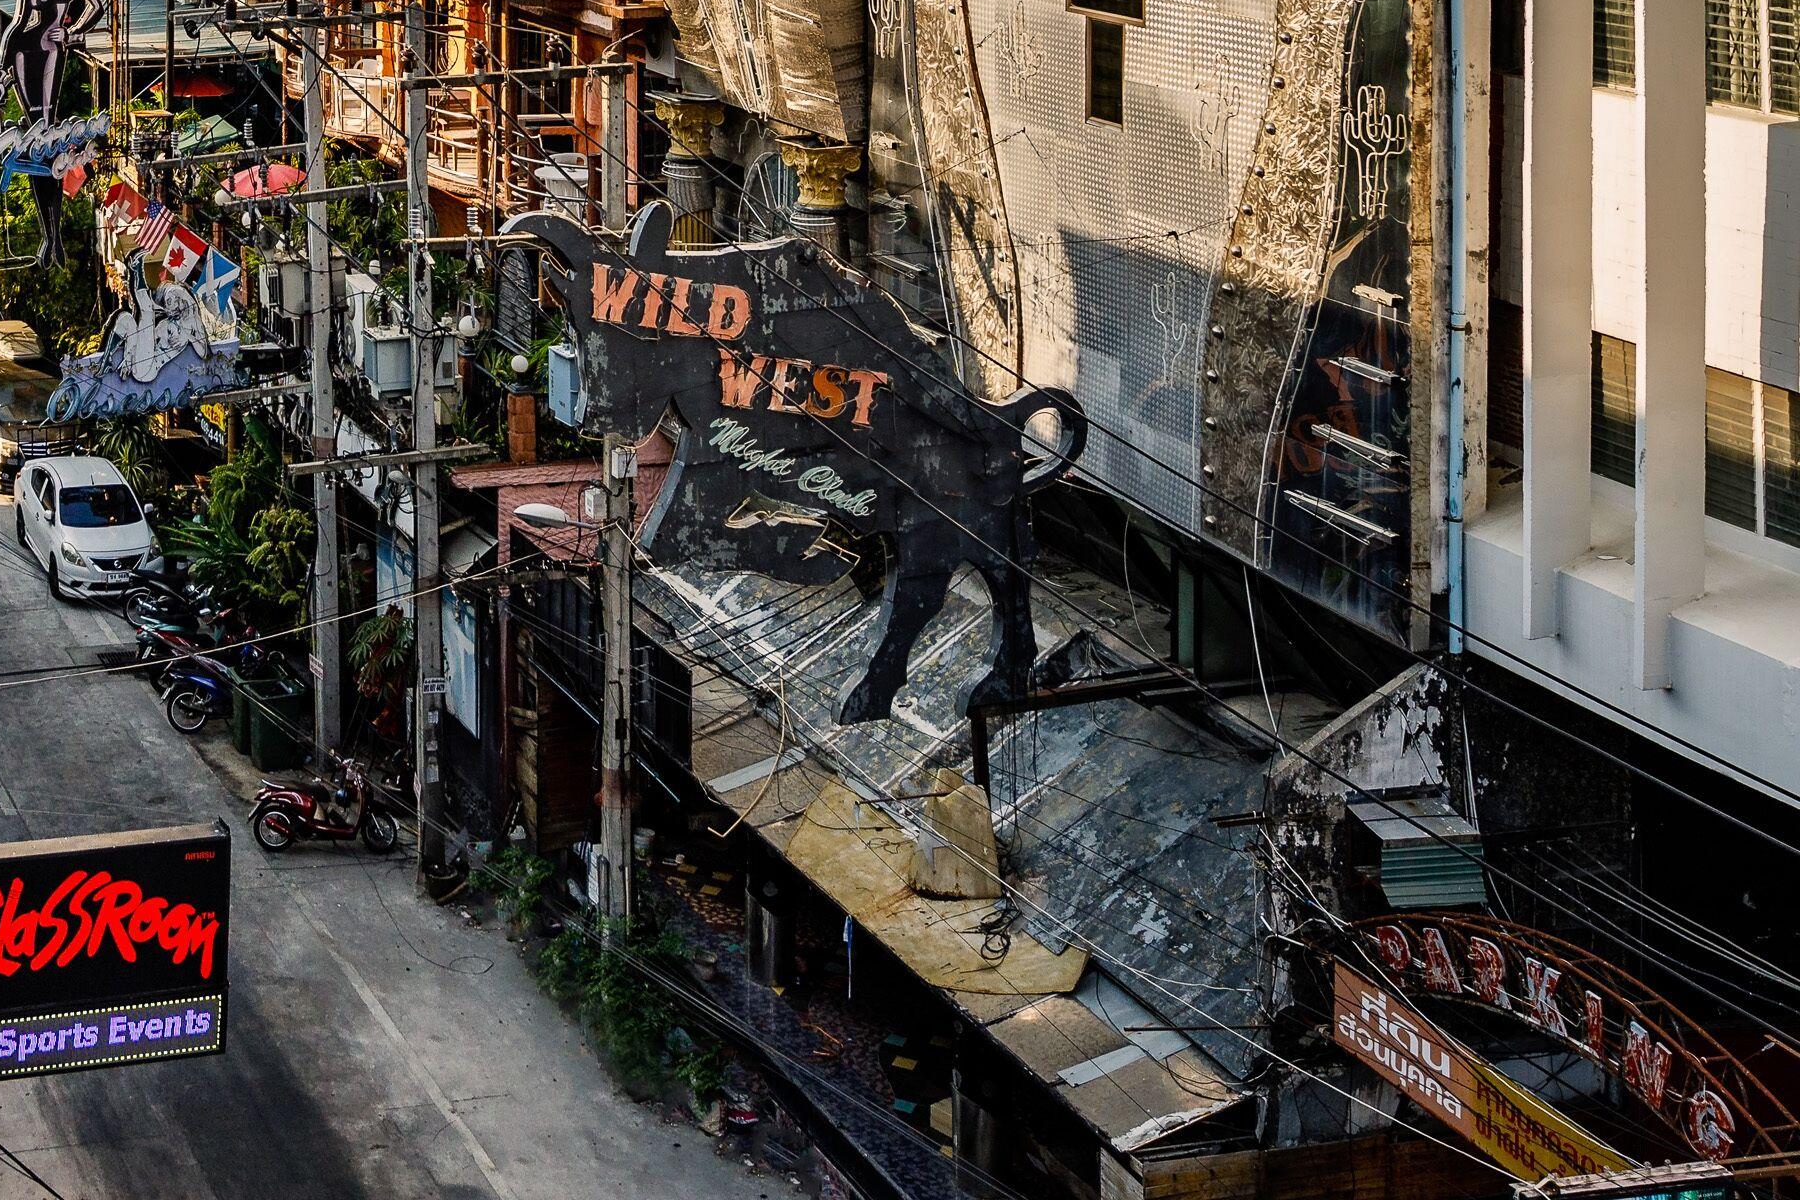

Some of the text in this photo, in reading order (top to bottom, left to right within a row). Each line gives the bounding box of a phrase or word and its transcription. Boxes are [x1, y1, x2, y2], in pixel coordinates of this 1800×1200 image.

[591, 262, 753, 341] WILD
[718, 347, 890, 430] WEST
[797, 465, 879, 517] Club
[108, 1009, 211, 1045] Events
[1338, 1012, 1463, 1120] ส่วนบุคคล
[1360, 990, 1451, 1079] ที่ดิน
